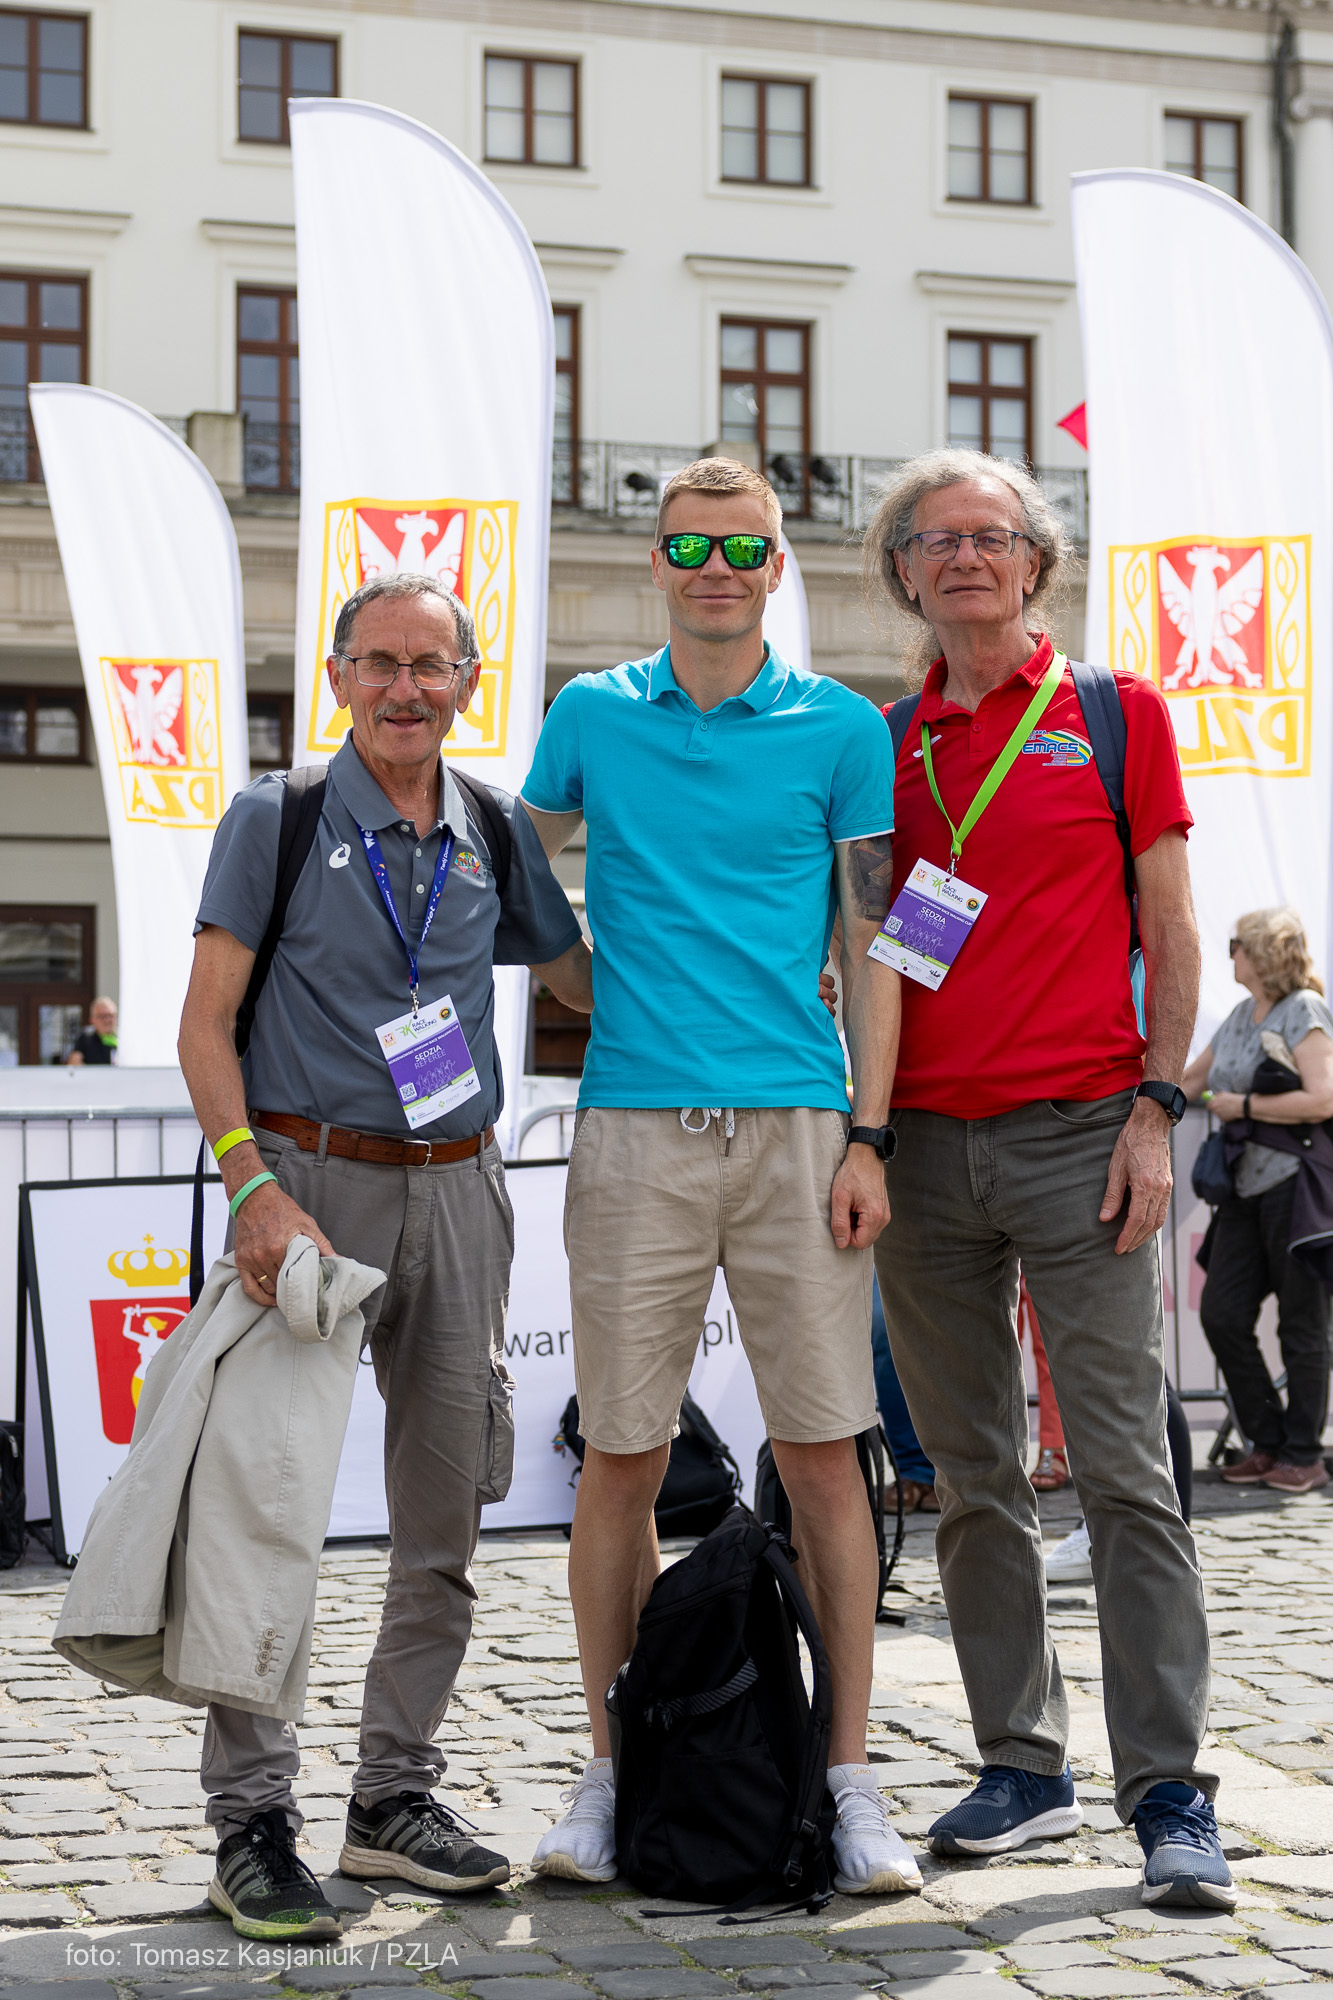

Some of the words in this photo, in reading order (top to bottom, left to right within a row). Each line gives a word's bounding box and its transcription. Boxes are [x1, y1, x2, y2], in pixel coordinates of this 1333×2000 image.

[1022, 742, 1079, 754] EMACS
[942, 888, 963, 903] WALKING
[943, 884, 957, 893] RACE
[915, 912, 946, 931] REFEREE
[920, 906, 946, 924] SĘDZIA
[412, 1019, 426, 1028] RACE
[414, 1019, 437, 1032] WALKING
[414, 1049, 446, 1069] REFEREE
[415, 1045, 442, 1062] SĘDZIA
[504, 1330, 570, 1358] war
[703, 1310, 732, 1357] pl
